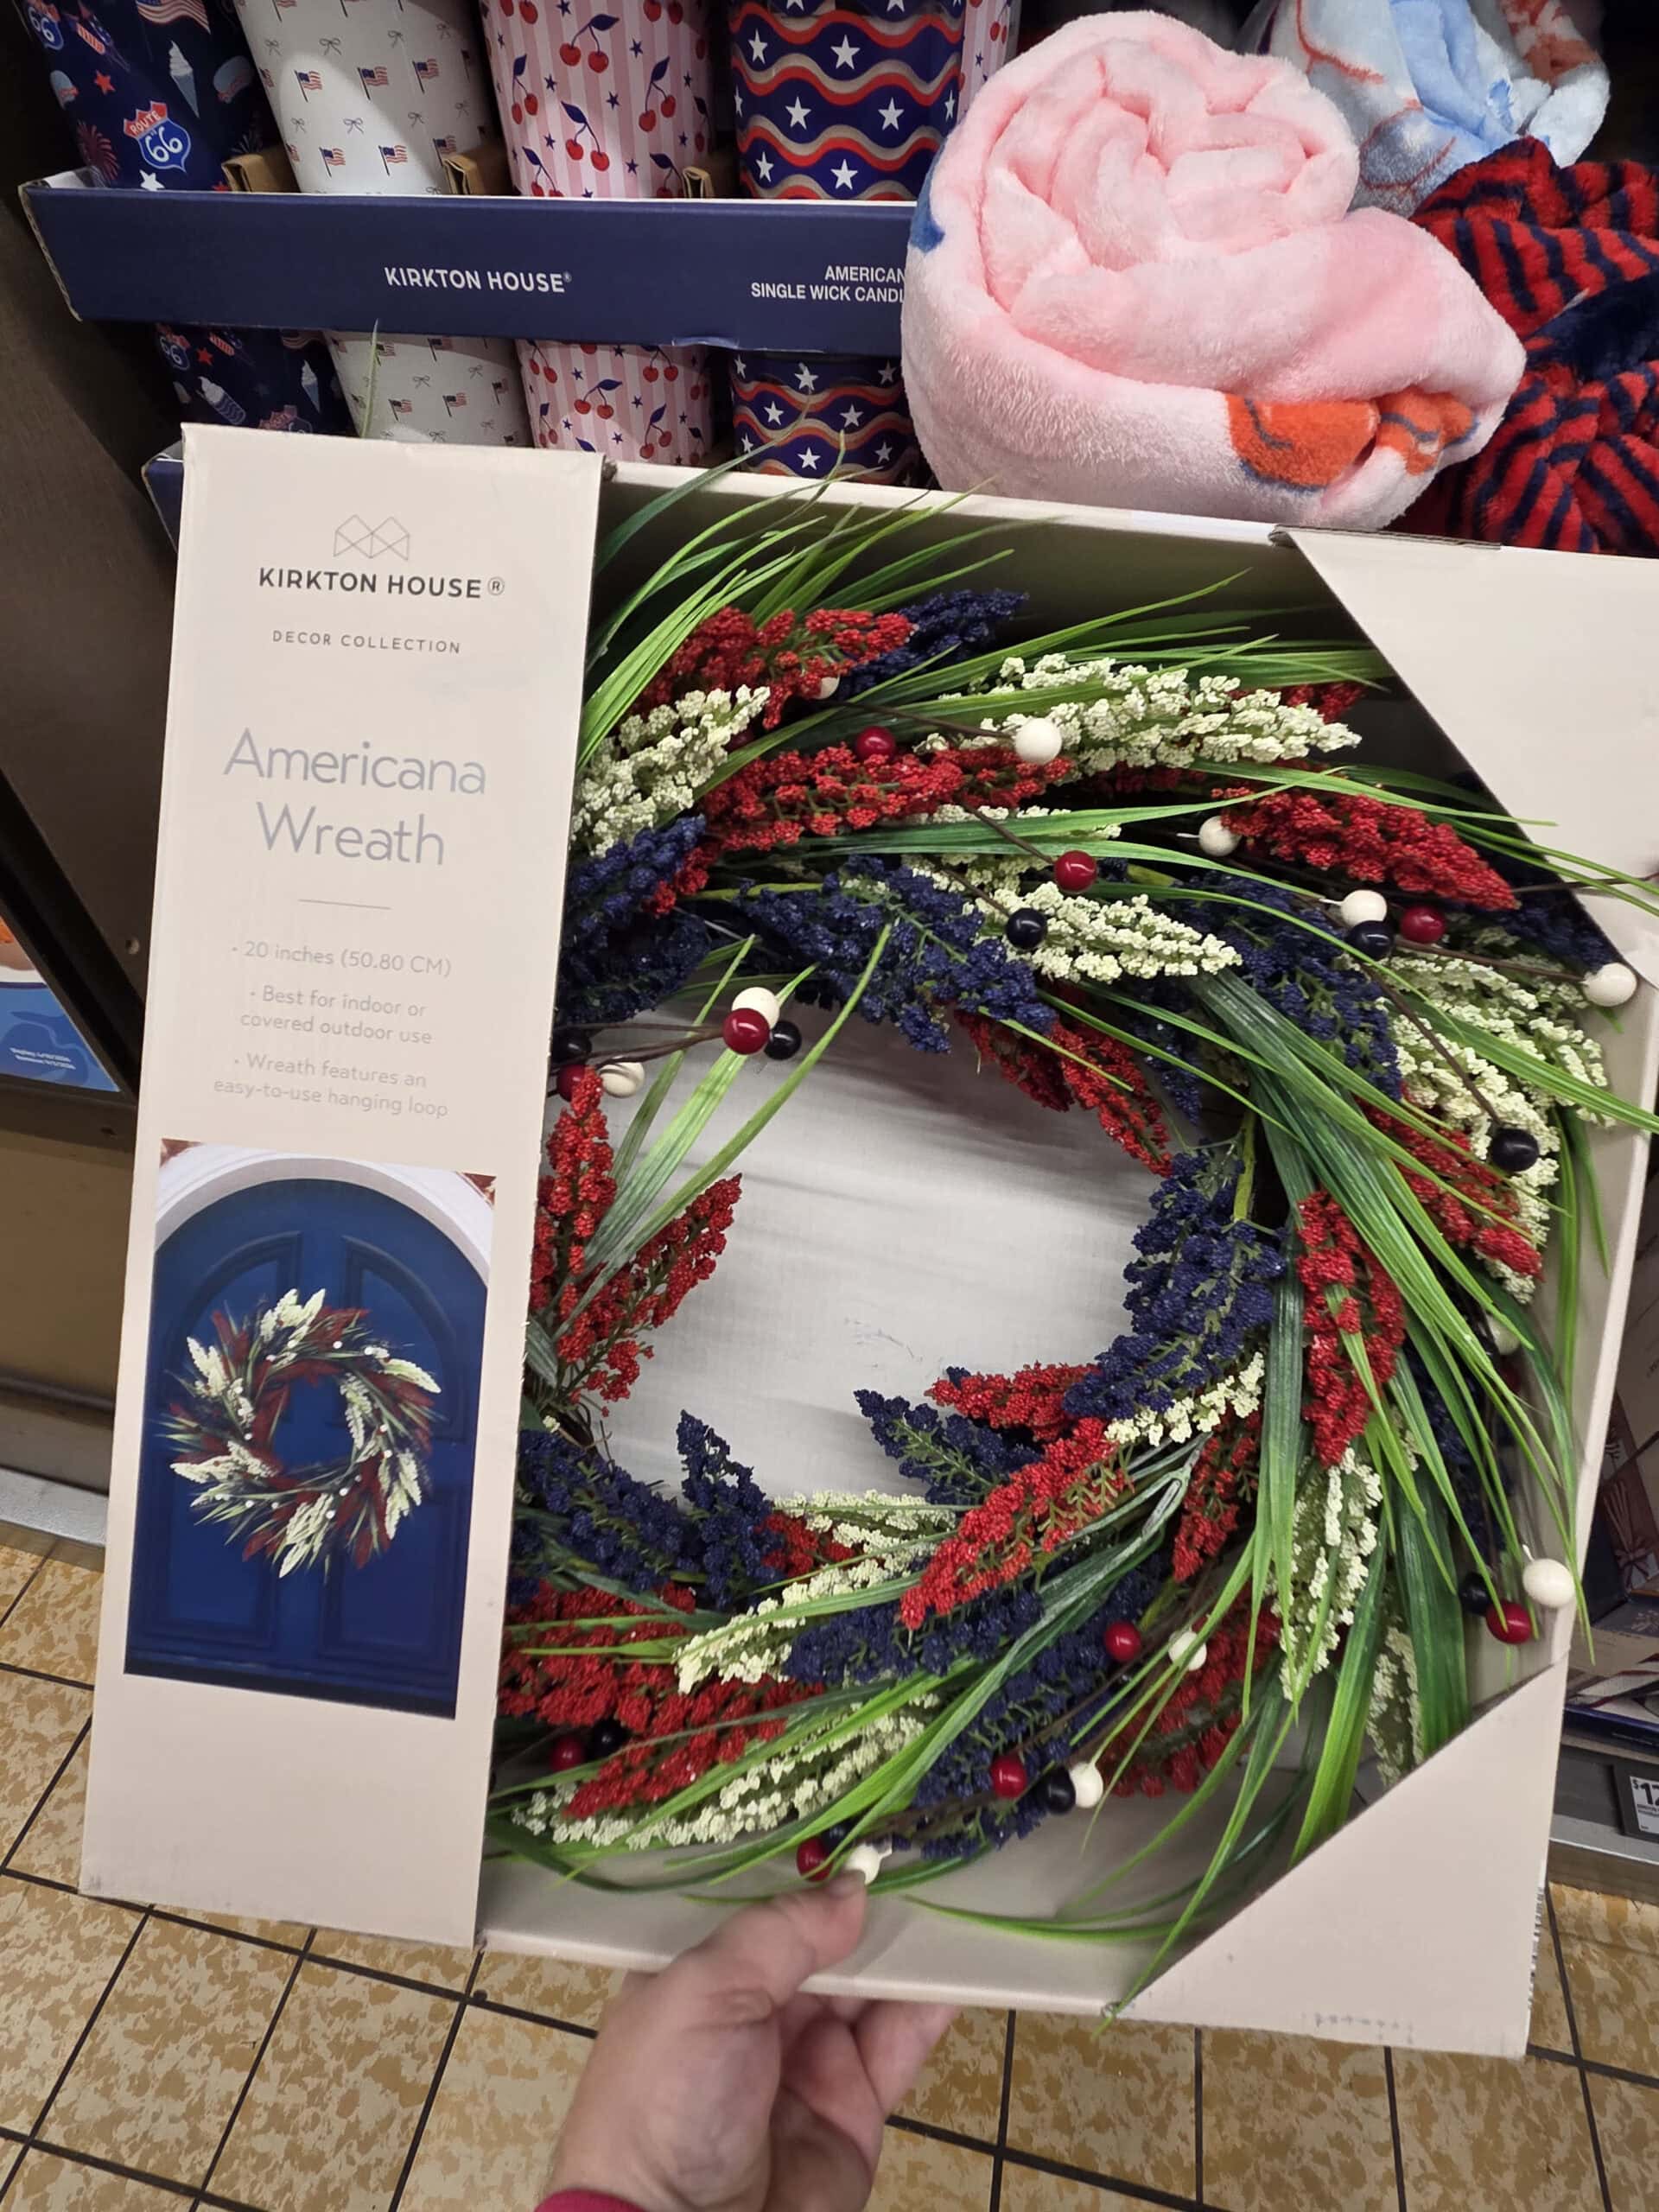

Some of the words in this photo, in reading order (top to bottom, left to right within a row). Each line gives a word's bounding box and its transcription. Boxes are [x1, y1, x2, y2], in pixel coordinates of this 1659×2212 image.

[130, 110, 161, 136] ROUTE
[145, 126, 183, 162] 66
[385, 267, 481, 289] KIRKTON
[751, 282, 806, 300] SINGLE
[810, 284, 851, 302] WICK
[259, 567, 377, 593] KIRKTON
[272, 630, 331, 645] DECOR
[340, 634, 460, 654] COLLECTION
[223, 727, 486, 794] Americana
[257, 801, 444, 865] Wreath
[245, 940, 269, 958] 20
[275, 944, 334, 965] inches
[340, 949, 404, 971] (50.80
[410, 955, 451, 977] CM)
[262, 985, 303, 1006] Best
[309, 989, 335, 1007] for
[342, 994, 401, 1015] indoor
[407, 1004, 427, 1017] or
[239, 1013, 315, 1033] covered
[320, 1020, 394, 1040] outdoor
[398, 1030, 433, 1044] use
[246, 1052, 315, 1076] Wreath
[321, 1060, 398, 1085] features
[404, 1073, 427, 1088] an
[214, 1079, 322, 1103] easy-to-use
[327, 1088, 403, 1116] hanging
[408, 1096, 448, 1119] loop
